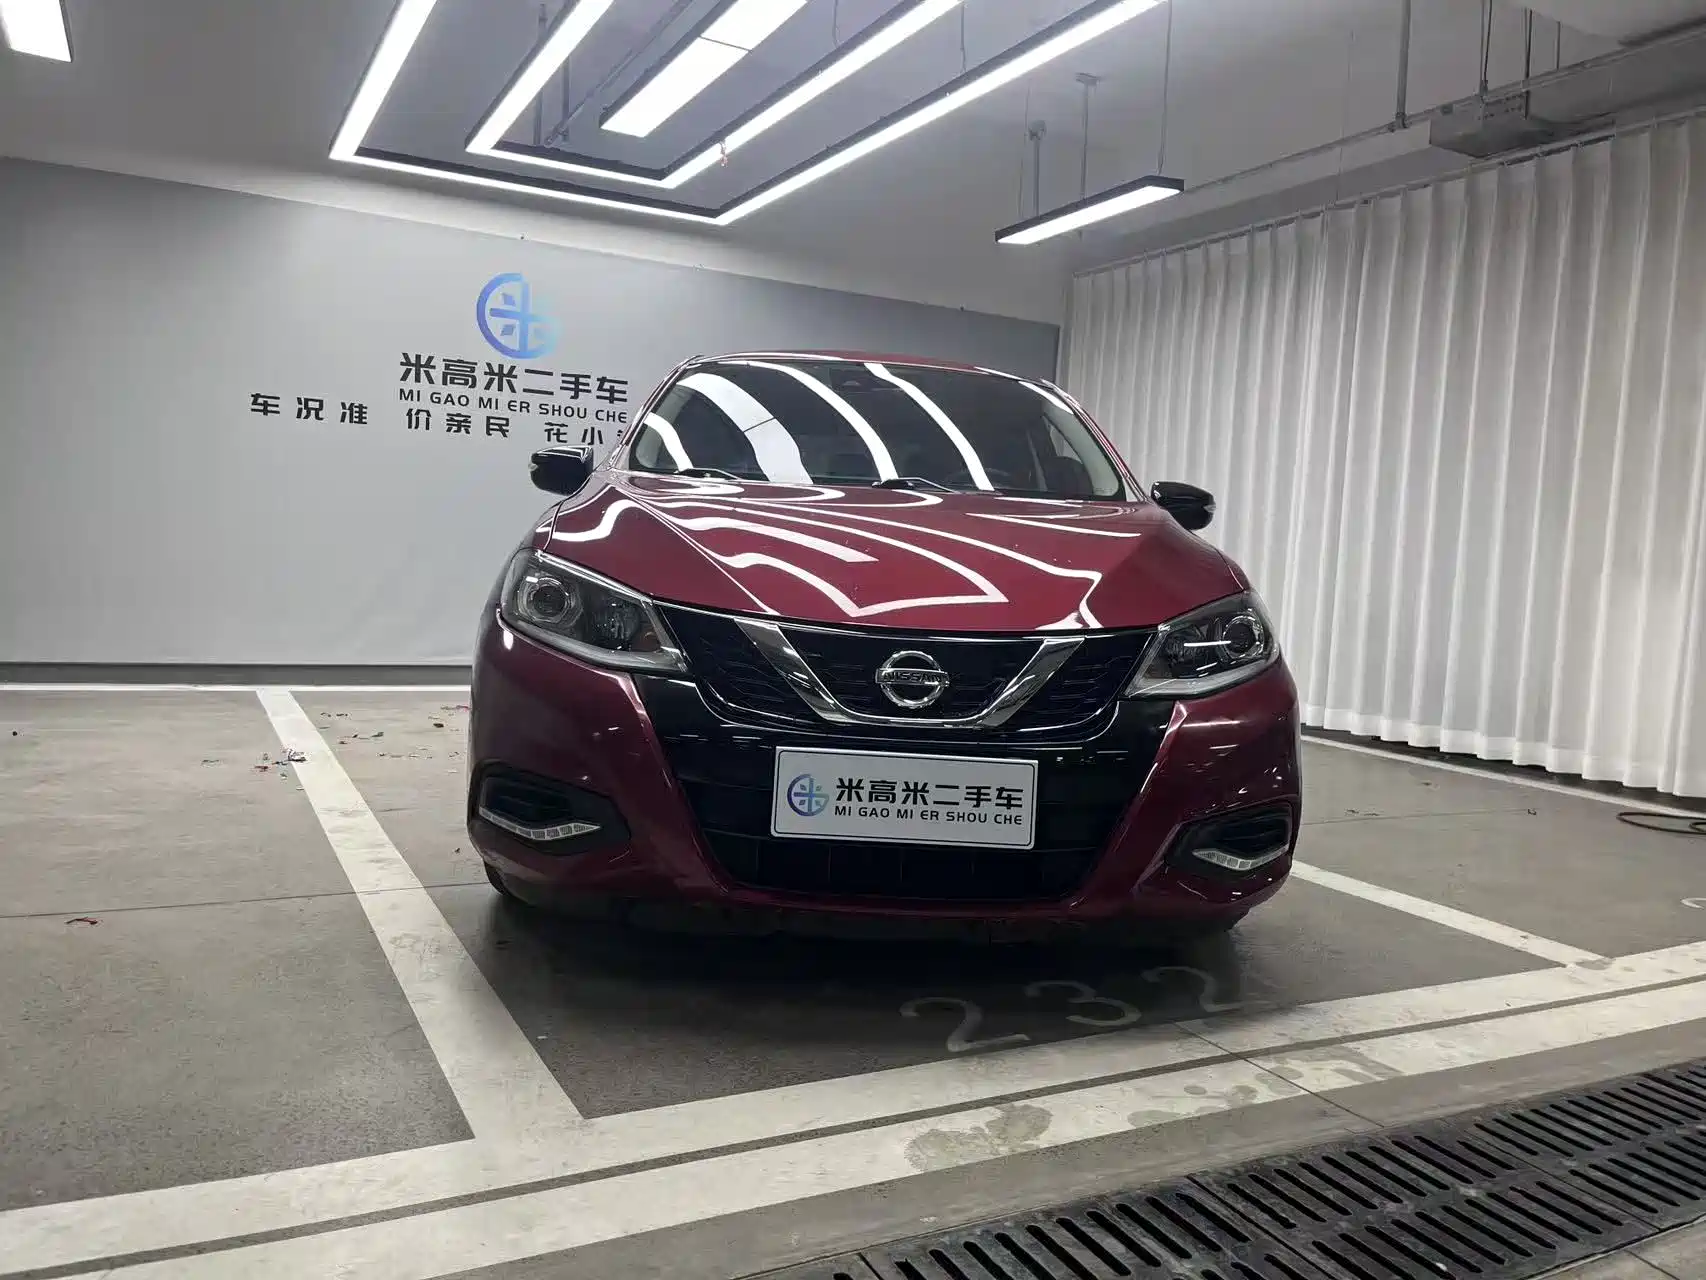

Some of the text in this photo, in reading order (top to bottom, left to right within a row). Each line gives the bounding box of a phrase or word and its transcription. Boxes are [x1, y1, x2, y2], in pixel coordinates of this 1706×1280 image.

[400, 352, 629, 404] 米高米二手车
[250, 393, 624, 446] 车况准 价亲民 花小
[400, 388, 628, 423] MI GAO MI ER SHOU CHE
[836, 777, 1023, 809] 米高米二手车
[834, 805, 1023, 825] MI GAO MI ER SHOU CHE
[899, 965, 1264, 1052] 232
